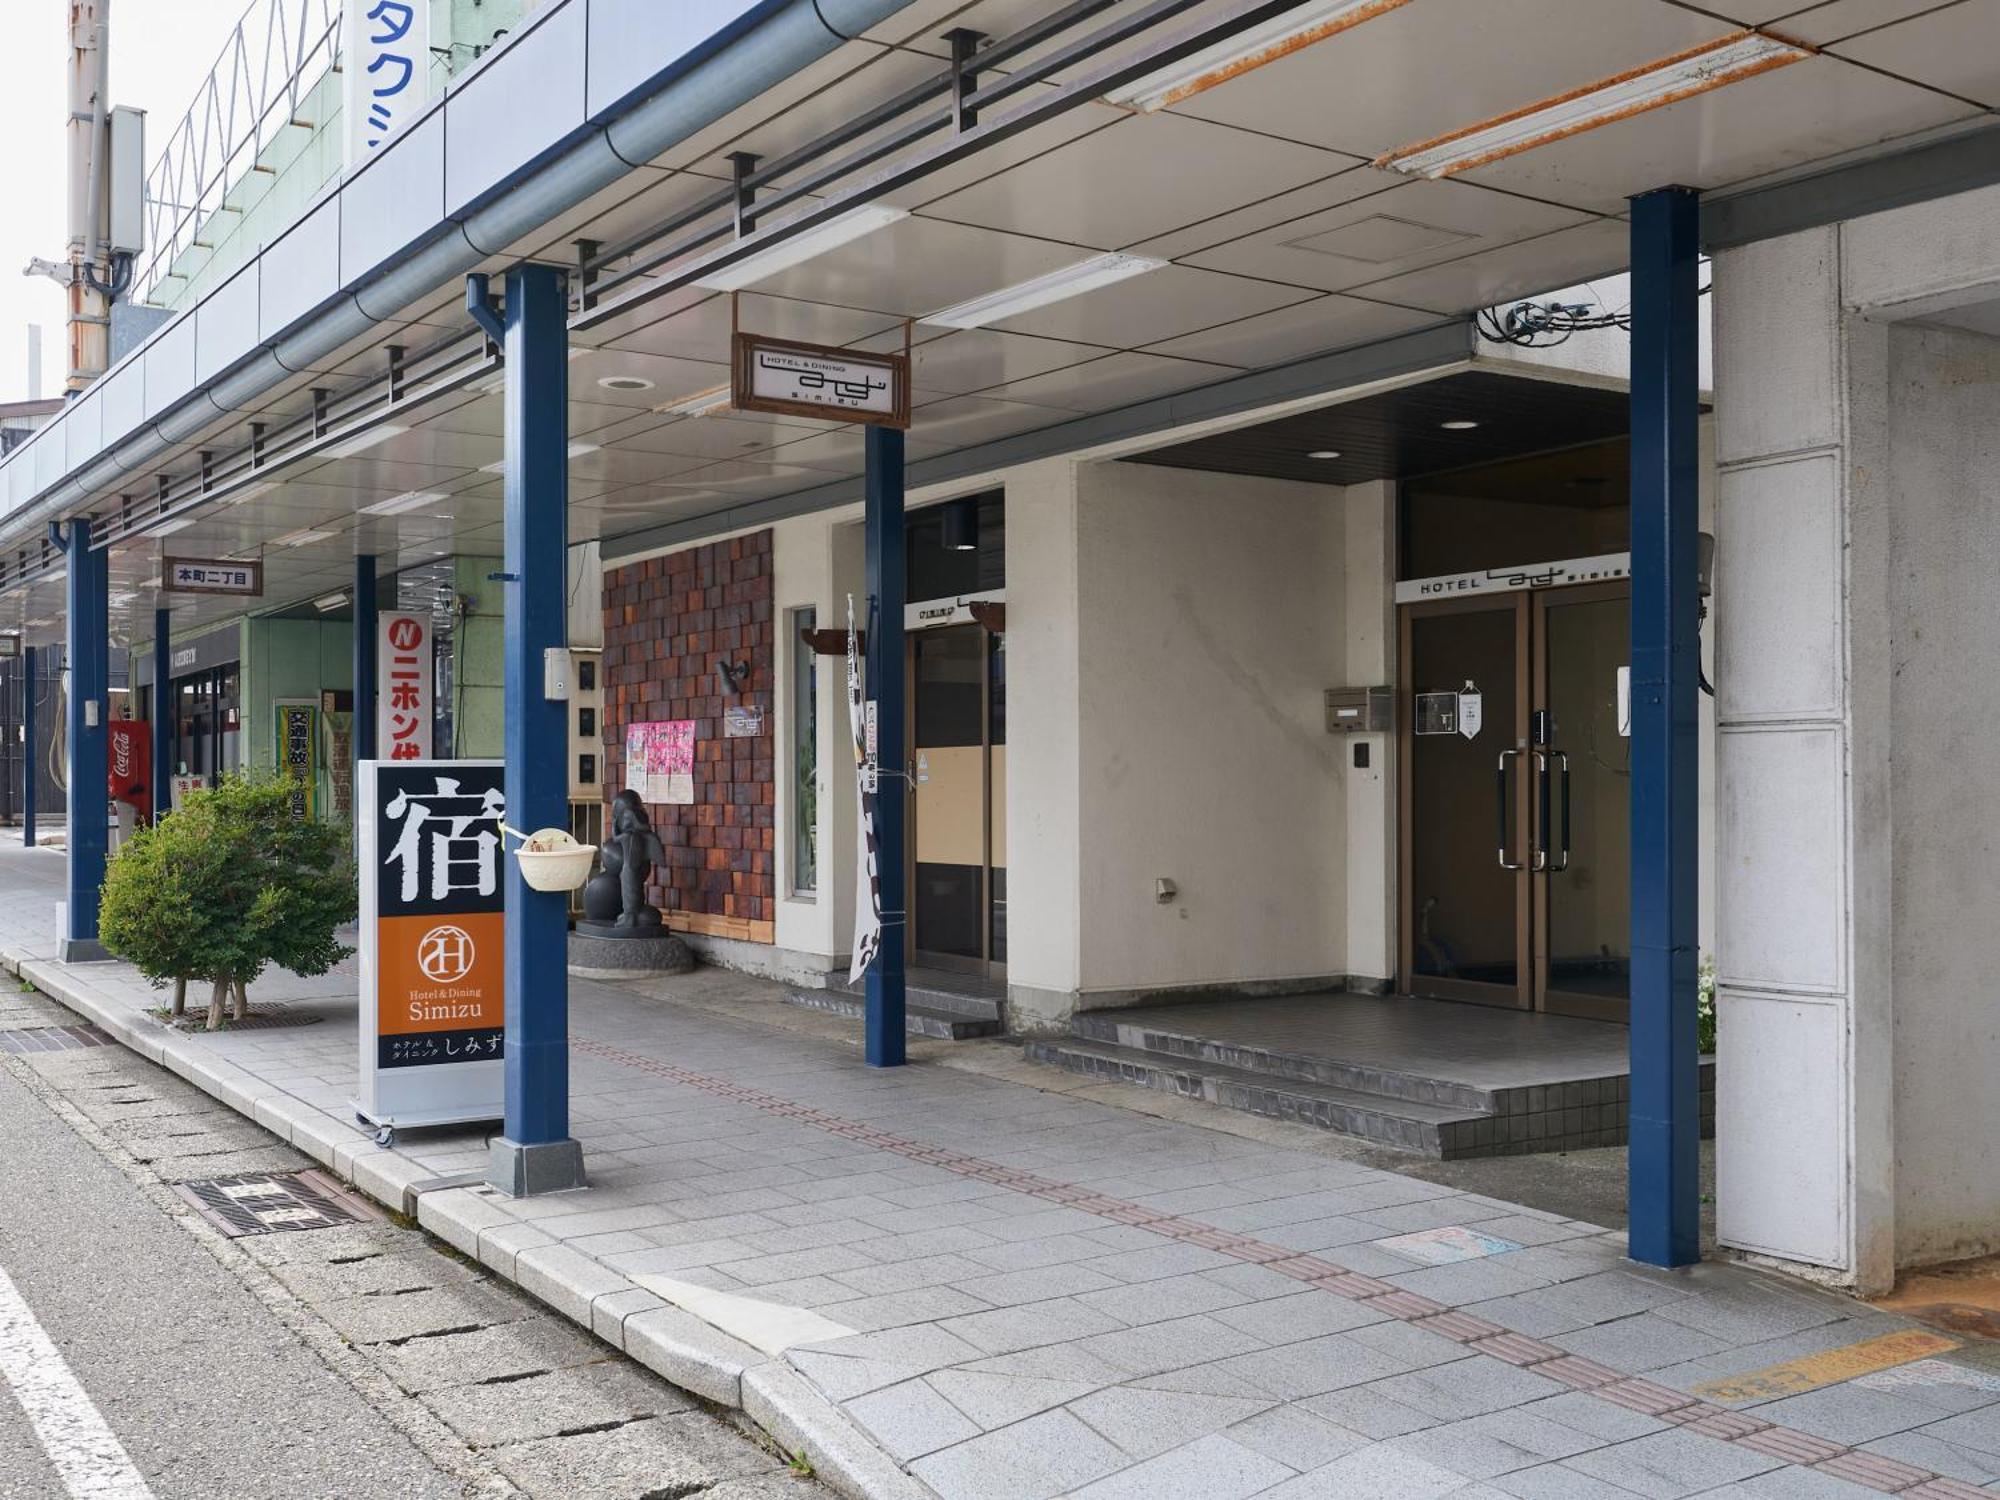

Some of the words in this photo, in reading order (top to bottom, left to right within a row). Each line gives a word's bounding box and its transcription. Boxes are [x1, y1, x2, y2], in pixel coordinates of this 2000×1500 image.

[767, 356, 801, 367] HOTEL
[811, 362, 846, 373] DINING
[179, 567, 247, 585] 本町二丁目
[1421, 579, 1481, 594] HOTEL
[384, 776, 505, 902] 宿
[410, 989, 437, 1000] Hotel
[438, 989, 447, 999] &
[448, 988, 482, 999] Dining
[409, 1000, 482, 1021] Simizu
[445, 1034, 503, 1055] しみず
